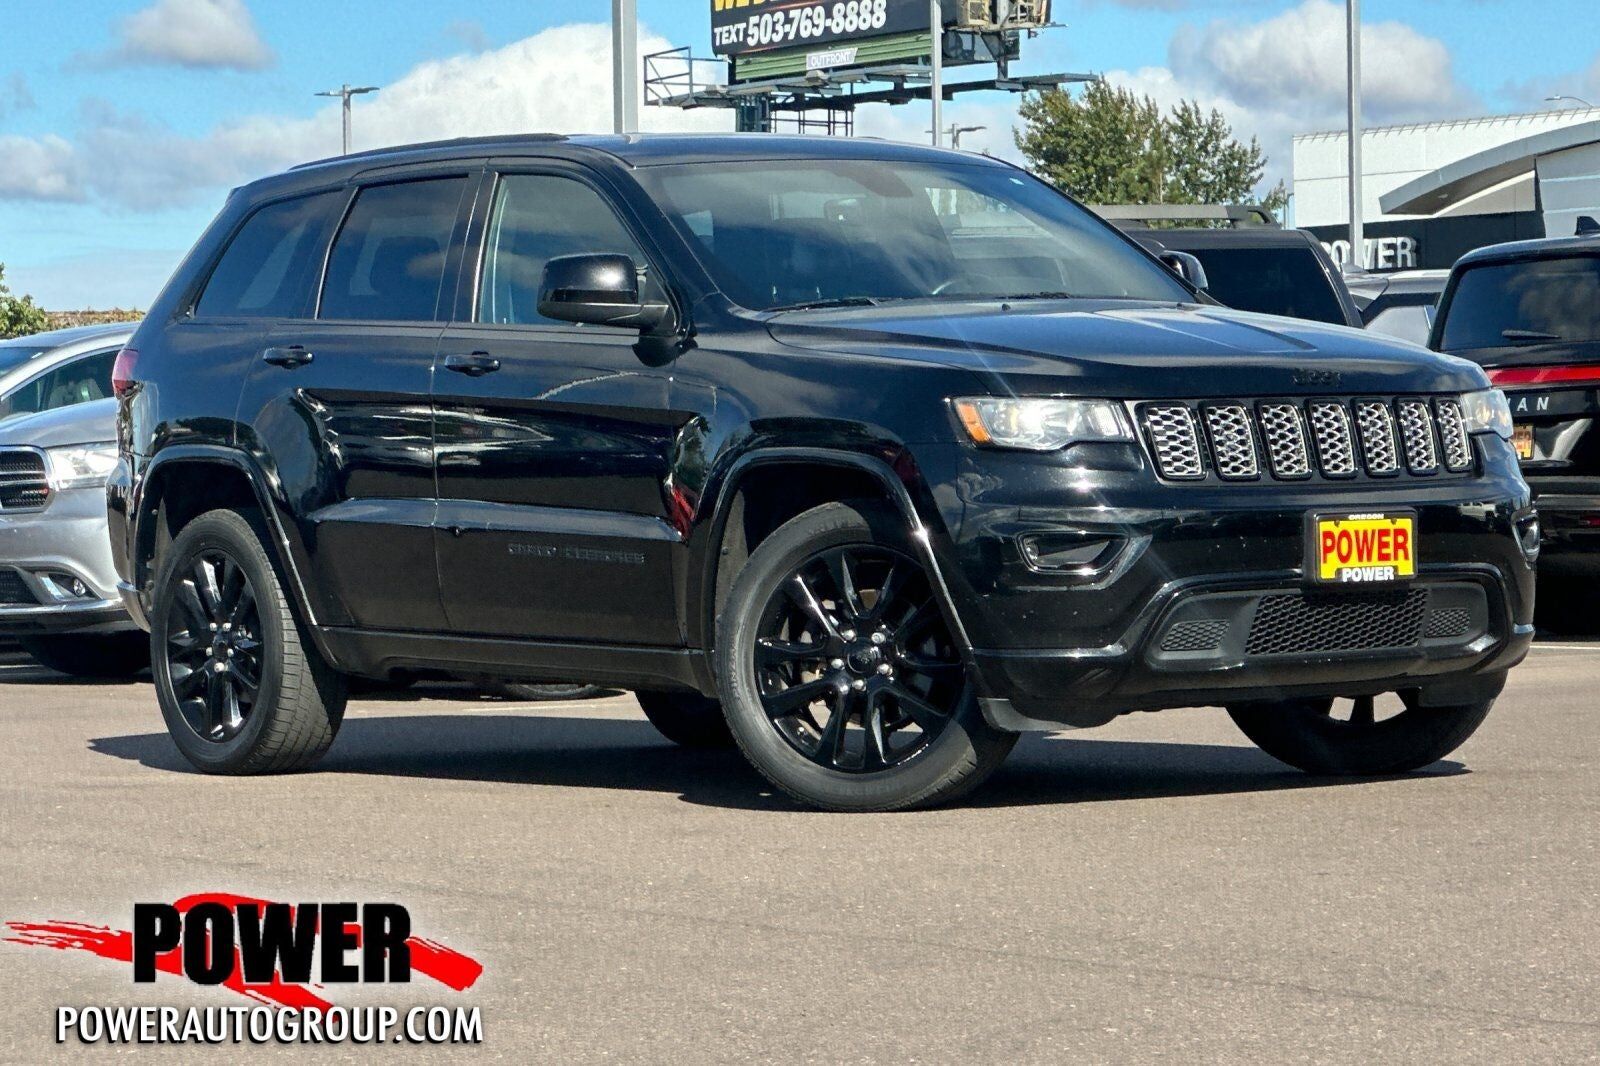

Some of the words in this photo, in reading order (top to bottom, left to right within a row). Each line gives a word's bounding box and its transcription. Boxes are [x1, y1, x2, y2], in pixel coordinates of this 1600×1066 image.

[714, 22, 747, 46] TEXT
[747, 0, 887, 47] 503-769-8888
[811, 51, 852, 67] OUTFRONT
[1507, 396, 1549, 412] AN
[1322, 528, 1409, 564] POWER
[1342, 566, 1395, 582] POWER
